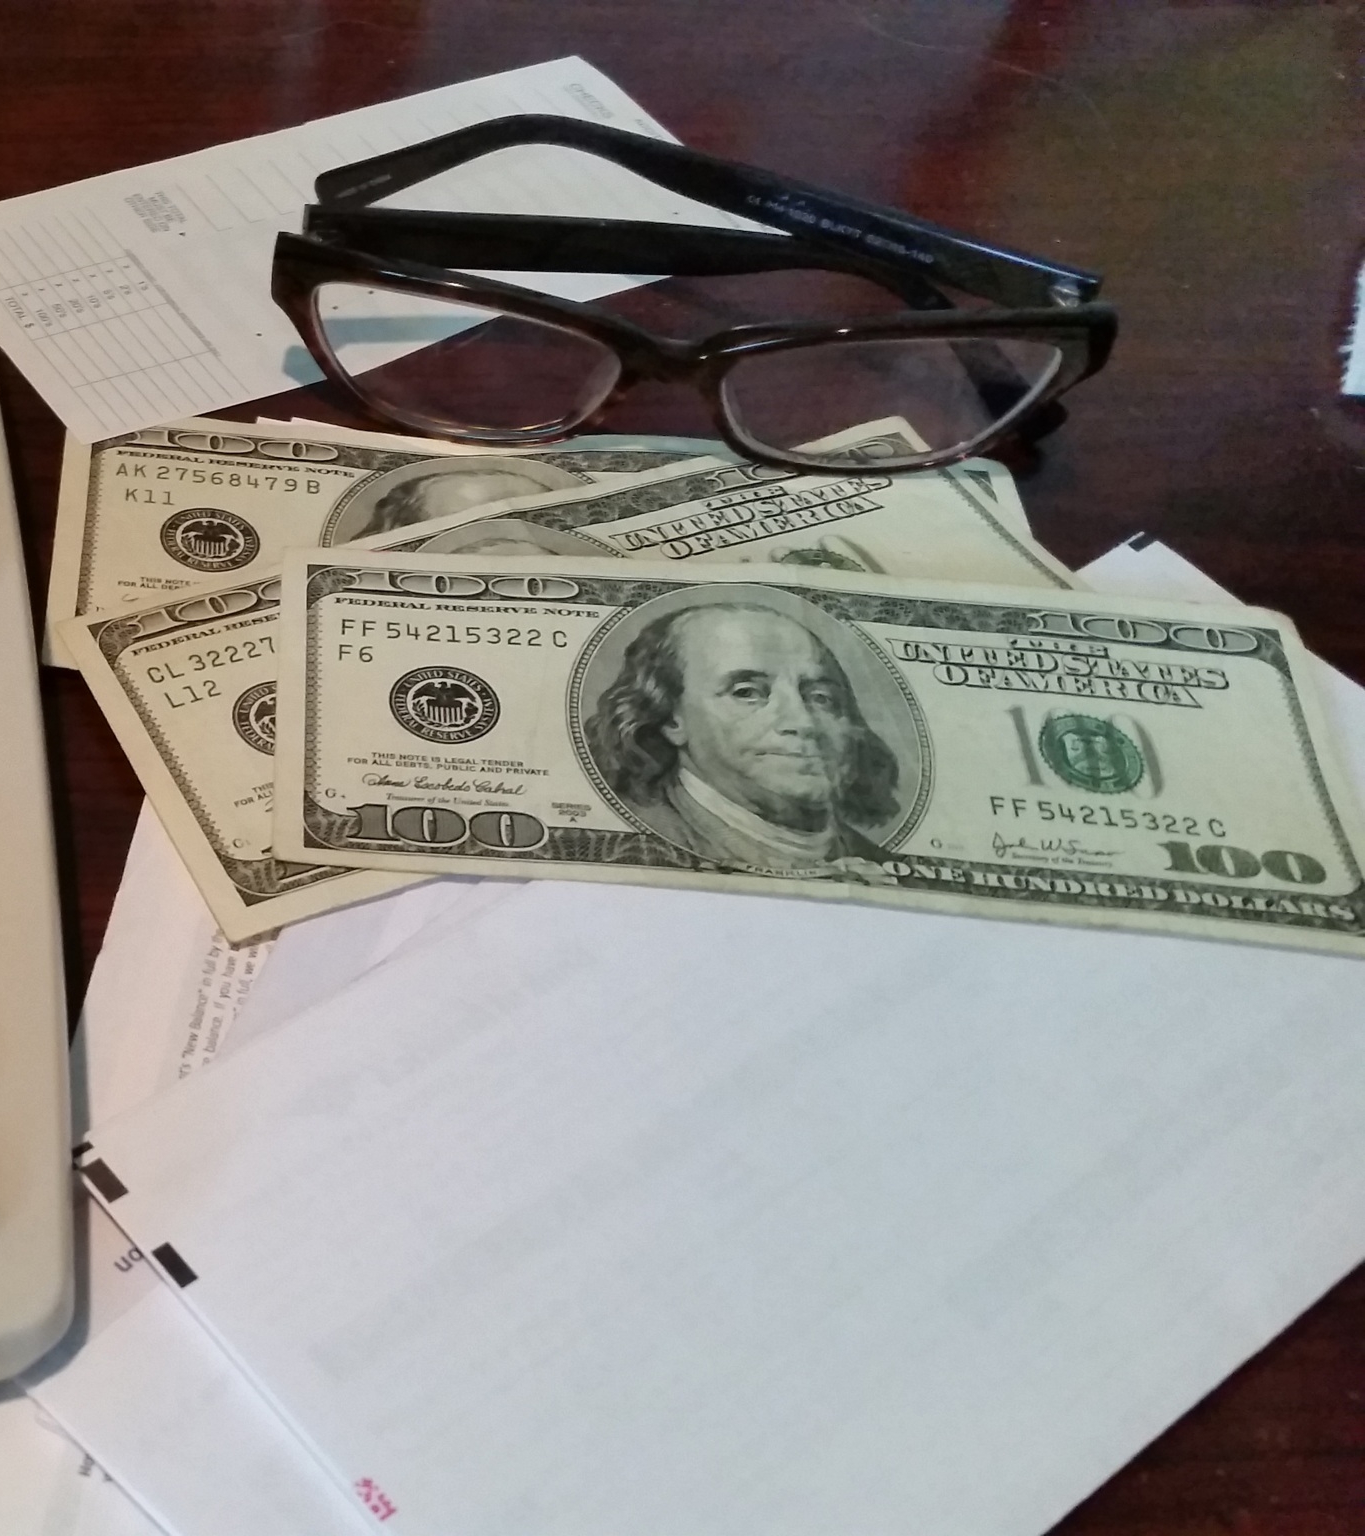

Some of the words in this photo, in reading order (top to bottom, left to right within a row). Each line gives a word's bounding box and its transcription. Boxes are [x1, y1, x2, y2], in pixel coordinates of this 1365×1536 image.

[5, 297, 26, 320] TOTAL
[116, 450, 205, 464] FEDERAL
[209, 456, 300, 472] RESERVE
[304, 467, 355, 478] NOTE
[610, 503, 755, 550] UNITED
[754, 476, 893, 520] STATES
[343, 571, 580, 599] 100
[335, 597, 431, 611] FEDERAL
[435, 603, 537, 614] RESERVE
[542, 608, 600, 618] NOTE
[131, 628, 221, 657] FEDERAL
[386, 622, 543, 646] 54215322
[1027, 610, 1259, 656] 100
[338, 644, 374, 663] F6
[885, 638, 1059, 673] UNITED
[1061, 656, 1229, 690] STATES
[164, 680, 222, 709] L12
[404, 670, 443, 688] UNITED
[447, 671, 481, 692] STATES
[994, 671, 1203, 709] AMERICA
[421, 727, 472, 740] RESERVE
[347, 757, 368, 765] FOR
[371, 758, 392, 766] ALL
[436, 763, 477, 772] PUBLIC
[480, 766, 505, 774] AND
[506, 767, 549, 777] PRIVATE
[371, 752, 396, 760] THIS
[399, 754, 428, 762] NOTE
[444, 757, 479, 765] LEGAL
[482, 759, 524, 767] TENDER
[346, 804, 549, 851] 100
[1038, 801, 1200, 837] 54215322
[1157, 841, 1327, 885] 100
[883, 861, 965, 883] ONE
[972, 871, 1169, 901] HUNDRED
[1173, 887, 1355, 921] DOLLARS
[222, 955, 238, 978] have
[218, 980, 234, 999] you
